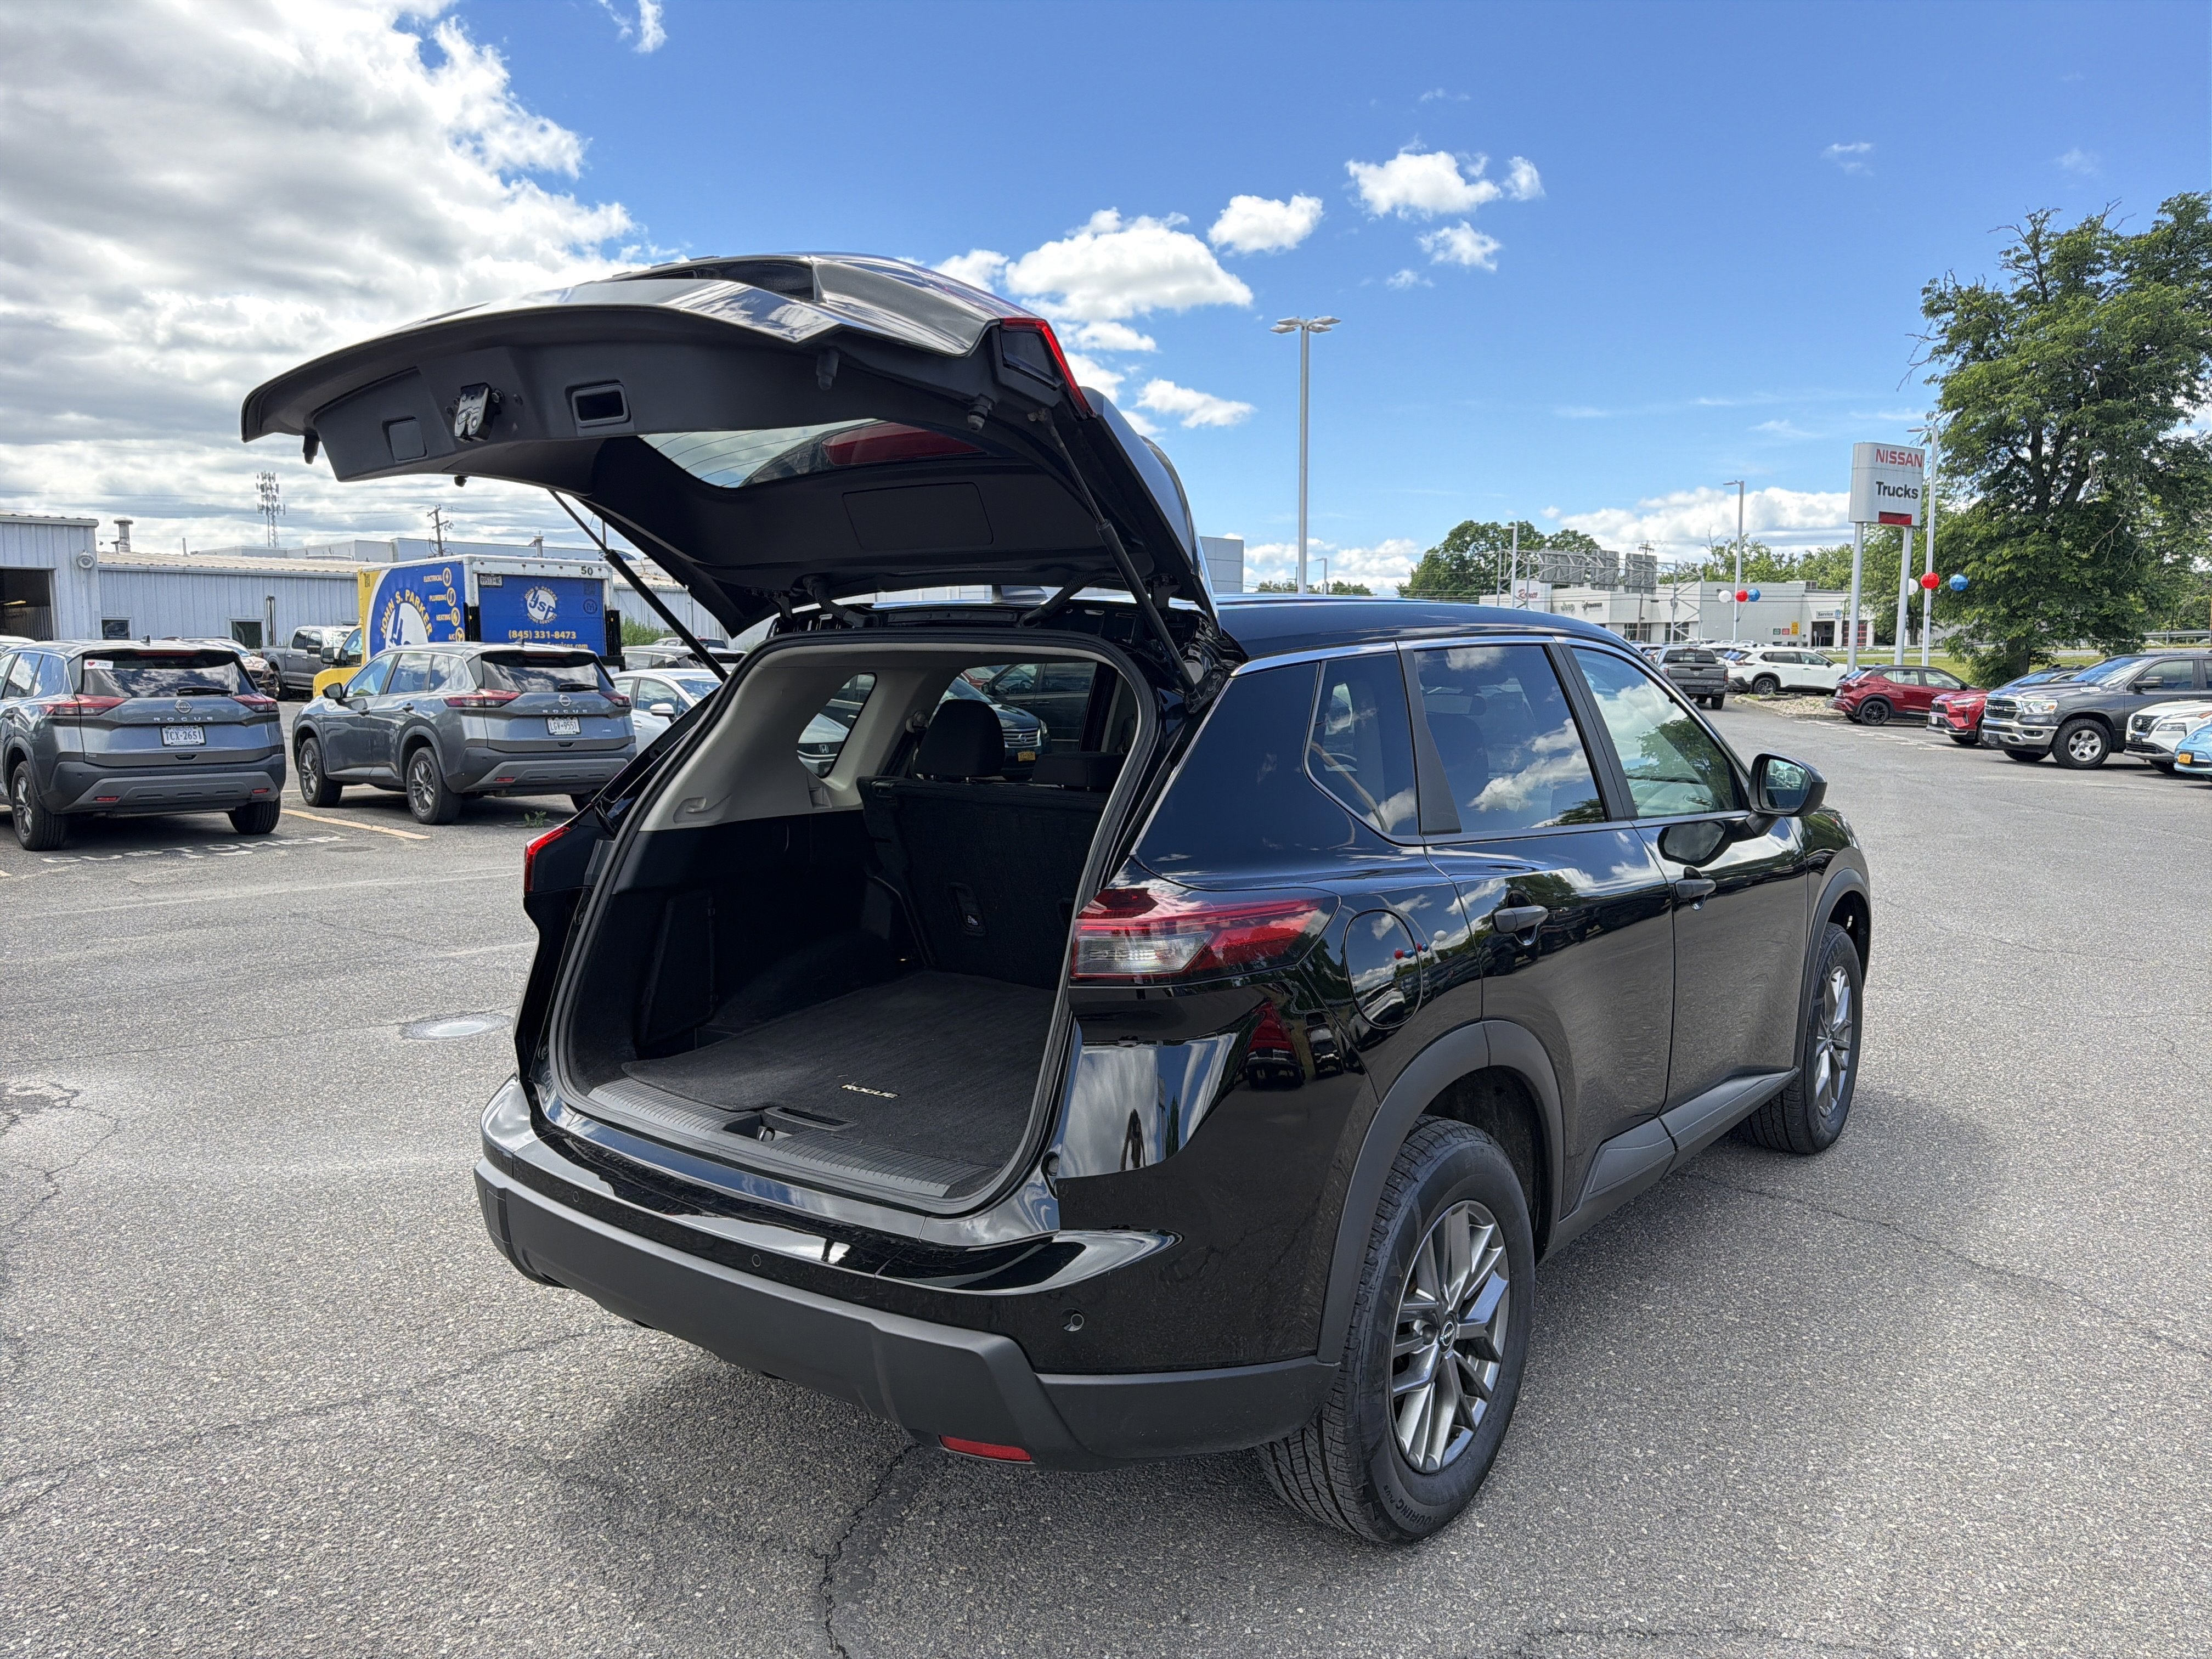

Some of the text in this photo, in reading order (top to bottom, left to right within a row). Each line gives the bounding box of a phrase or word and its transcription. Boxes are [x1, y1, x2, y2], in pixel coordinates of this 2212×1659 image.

[1876, 448, 1923, 468] NISSAN
[1876, 481, 1918, 499] Trucks
[423, 574, 443, 583] ELECTRICAL
[581, 566, 594, 575] 50
[380, 598, 395, 639] JOHN
[395, 591, 403, 604] S.
[405, 589, 433, 637] PARKER
[509, 630, 577, 640] (845) 331-8473
[41, 836, 347, 863] CUSTOMER
[841, 1084, 899, 1099] ROGUE
[1383, 1485, 1395, 1504] PLUS
